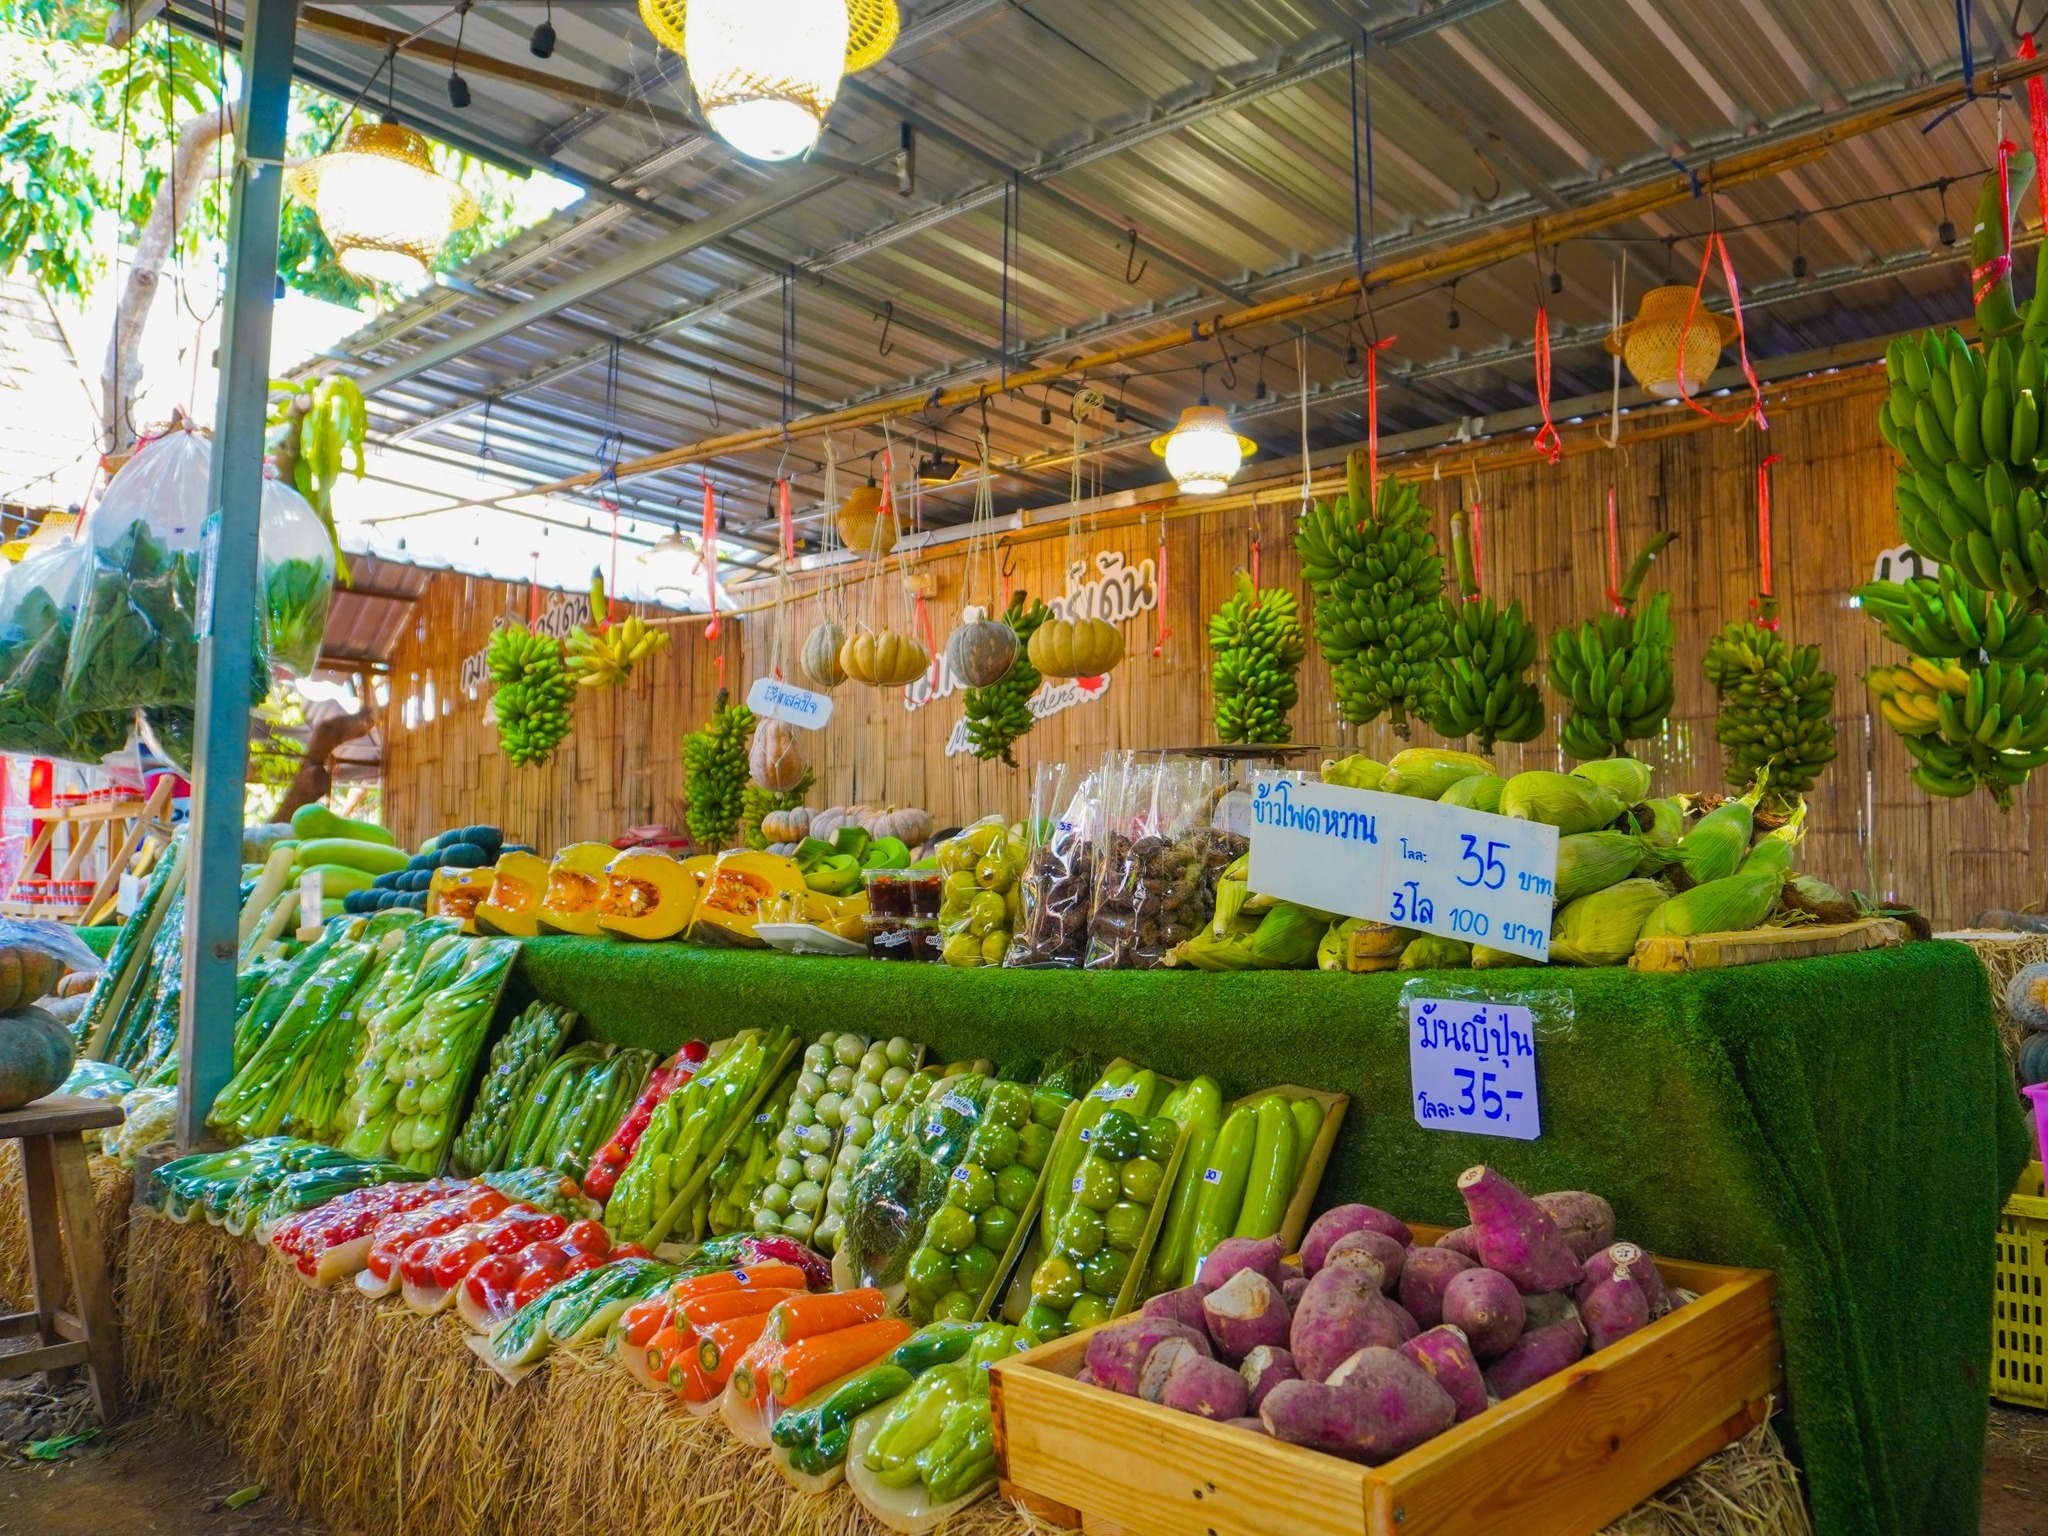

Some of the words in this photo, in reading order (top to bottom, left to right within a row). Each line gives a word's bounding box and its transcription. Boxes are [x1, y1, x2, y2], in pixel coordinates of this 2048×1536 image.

[1253, 781, 1378, 844] ข้าวโพดหวาน
[1456, 834, 1511, 890] 35
[1449, 908, 1490, 936] 100
[1417, 1003, 1533, 1068] มันญี่ปุ่น
[795, 1125, 809, 1135] 30
[928, 1124, 942, 1133] 35
[953, 1169, 969, 1181] 35
[1206, 1169, 1217, 1181] 30
